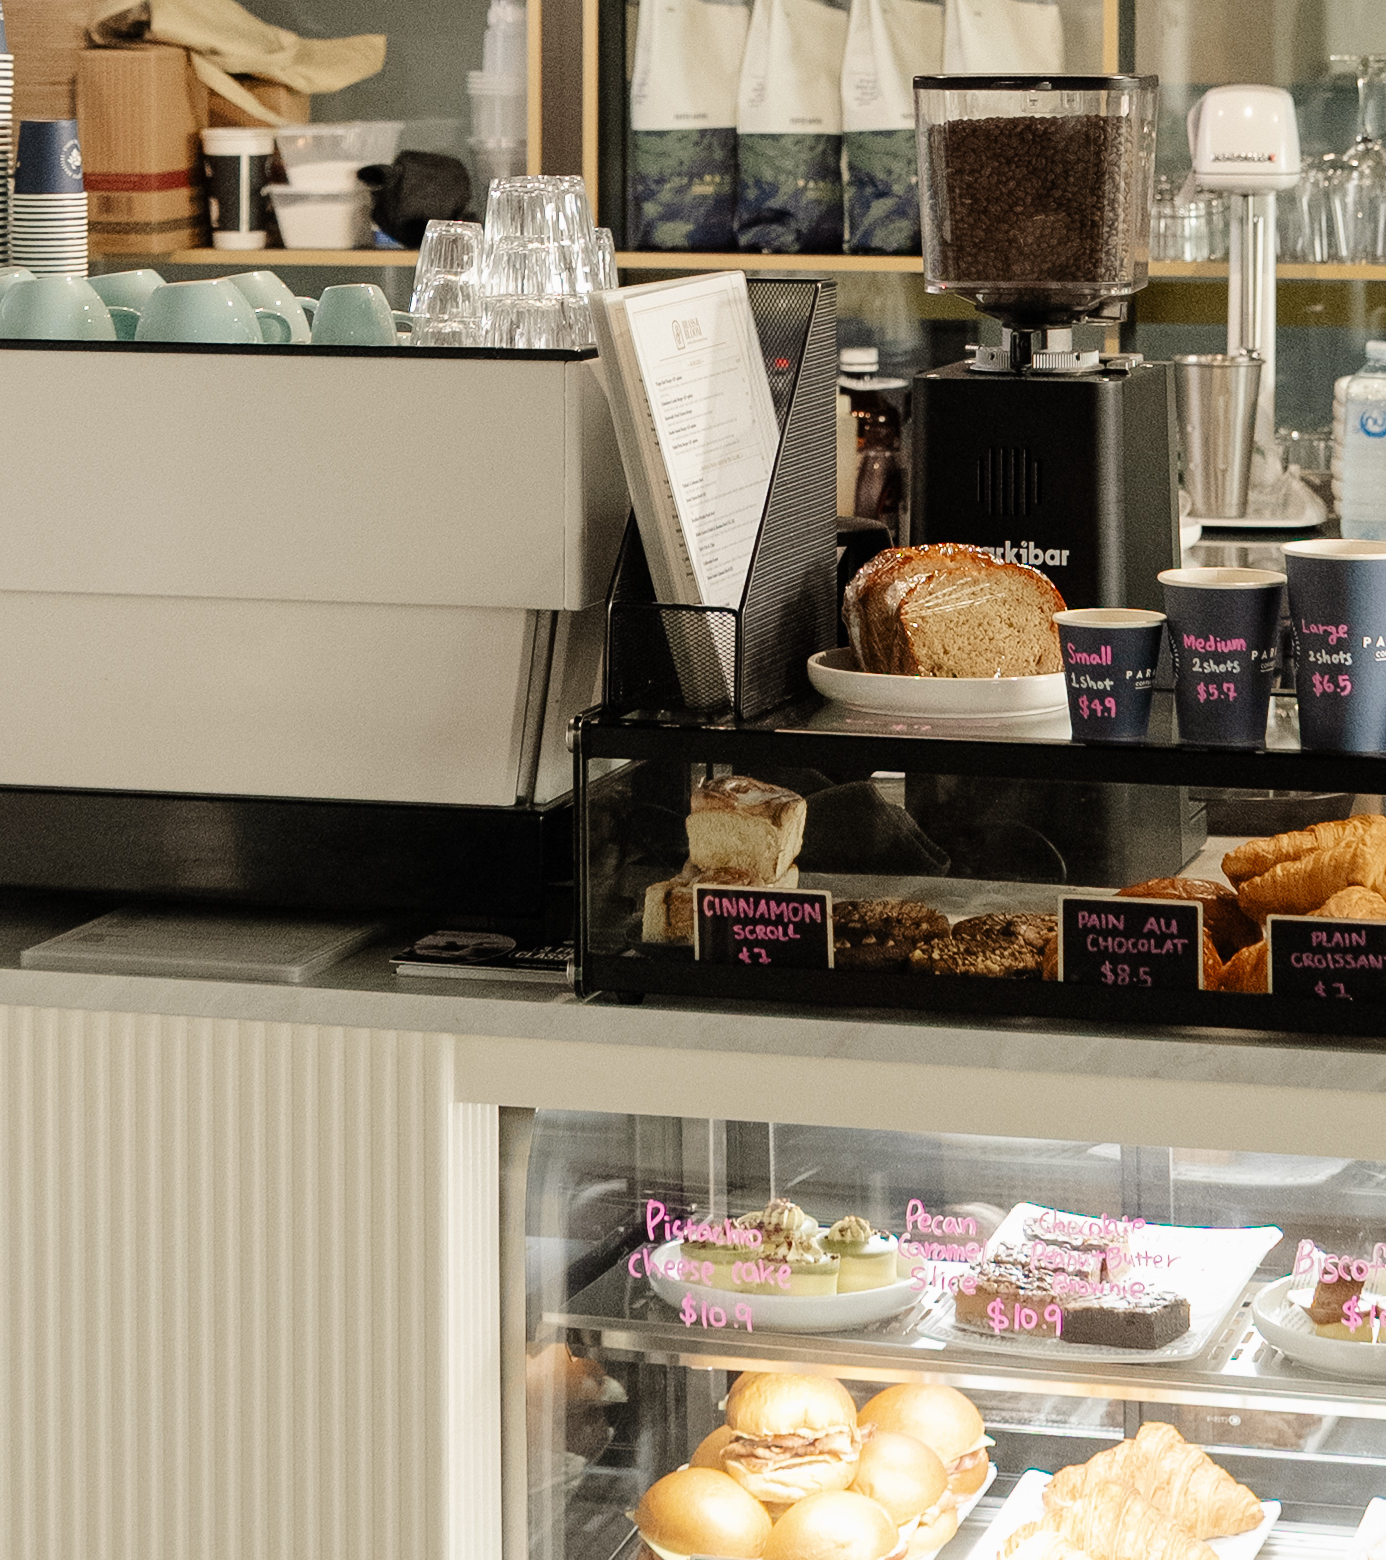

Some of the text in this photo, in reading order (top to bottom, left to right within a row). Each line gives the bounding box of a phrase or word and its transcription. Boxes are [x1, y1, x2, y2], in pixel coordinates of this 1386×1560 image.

[1183, 633, 1247, 653] Medium
[1301, 618, 1349, 646] Large
[1067, 643, 1112, 665] Small
[1196, 682, 1237, 703] $5.7
[1312, 671, 1353, 697] $6.5
[1078, 694, 1117, 719] $4.9
[703, 895, 822, 924] CINNAMON
[1078, 911, 1178, 935] PAIN AU
[733, 923, 801, 941] SCROLL
[1087, 934, 1188, 955] CHOCOLAT
[1312, 930, 1367, 947] PLAIN
[1101, 960, 1152, 987] $8.5
[645, 1198, 763, 1249] Pistachio
[905, 1198, 977, 1237] Pecan
[1038, 1210, 1146, 1238] Chocolate
[898, 1233, 988, 1263] Caramel
[1029, 1240, 1182, 1275] Peanut Butter
[732, 1258, 792, 1290] cake
[910, 1265, 977, 1296] Slice
[1052, 1271, 1146, 1299] Brownie
[679, 1292, 753, 1333] $10.9
[987, 1298, 1063, 1337] $10.9
